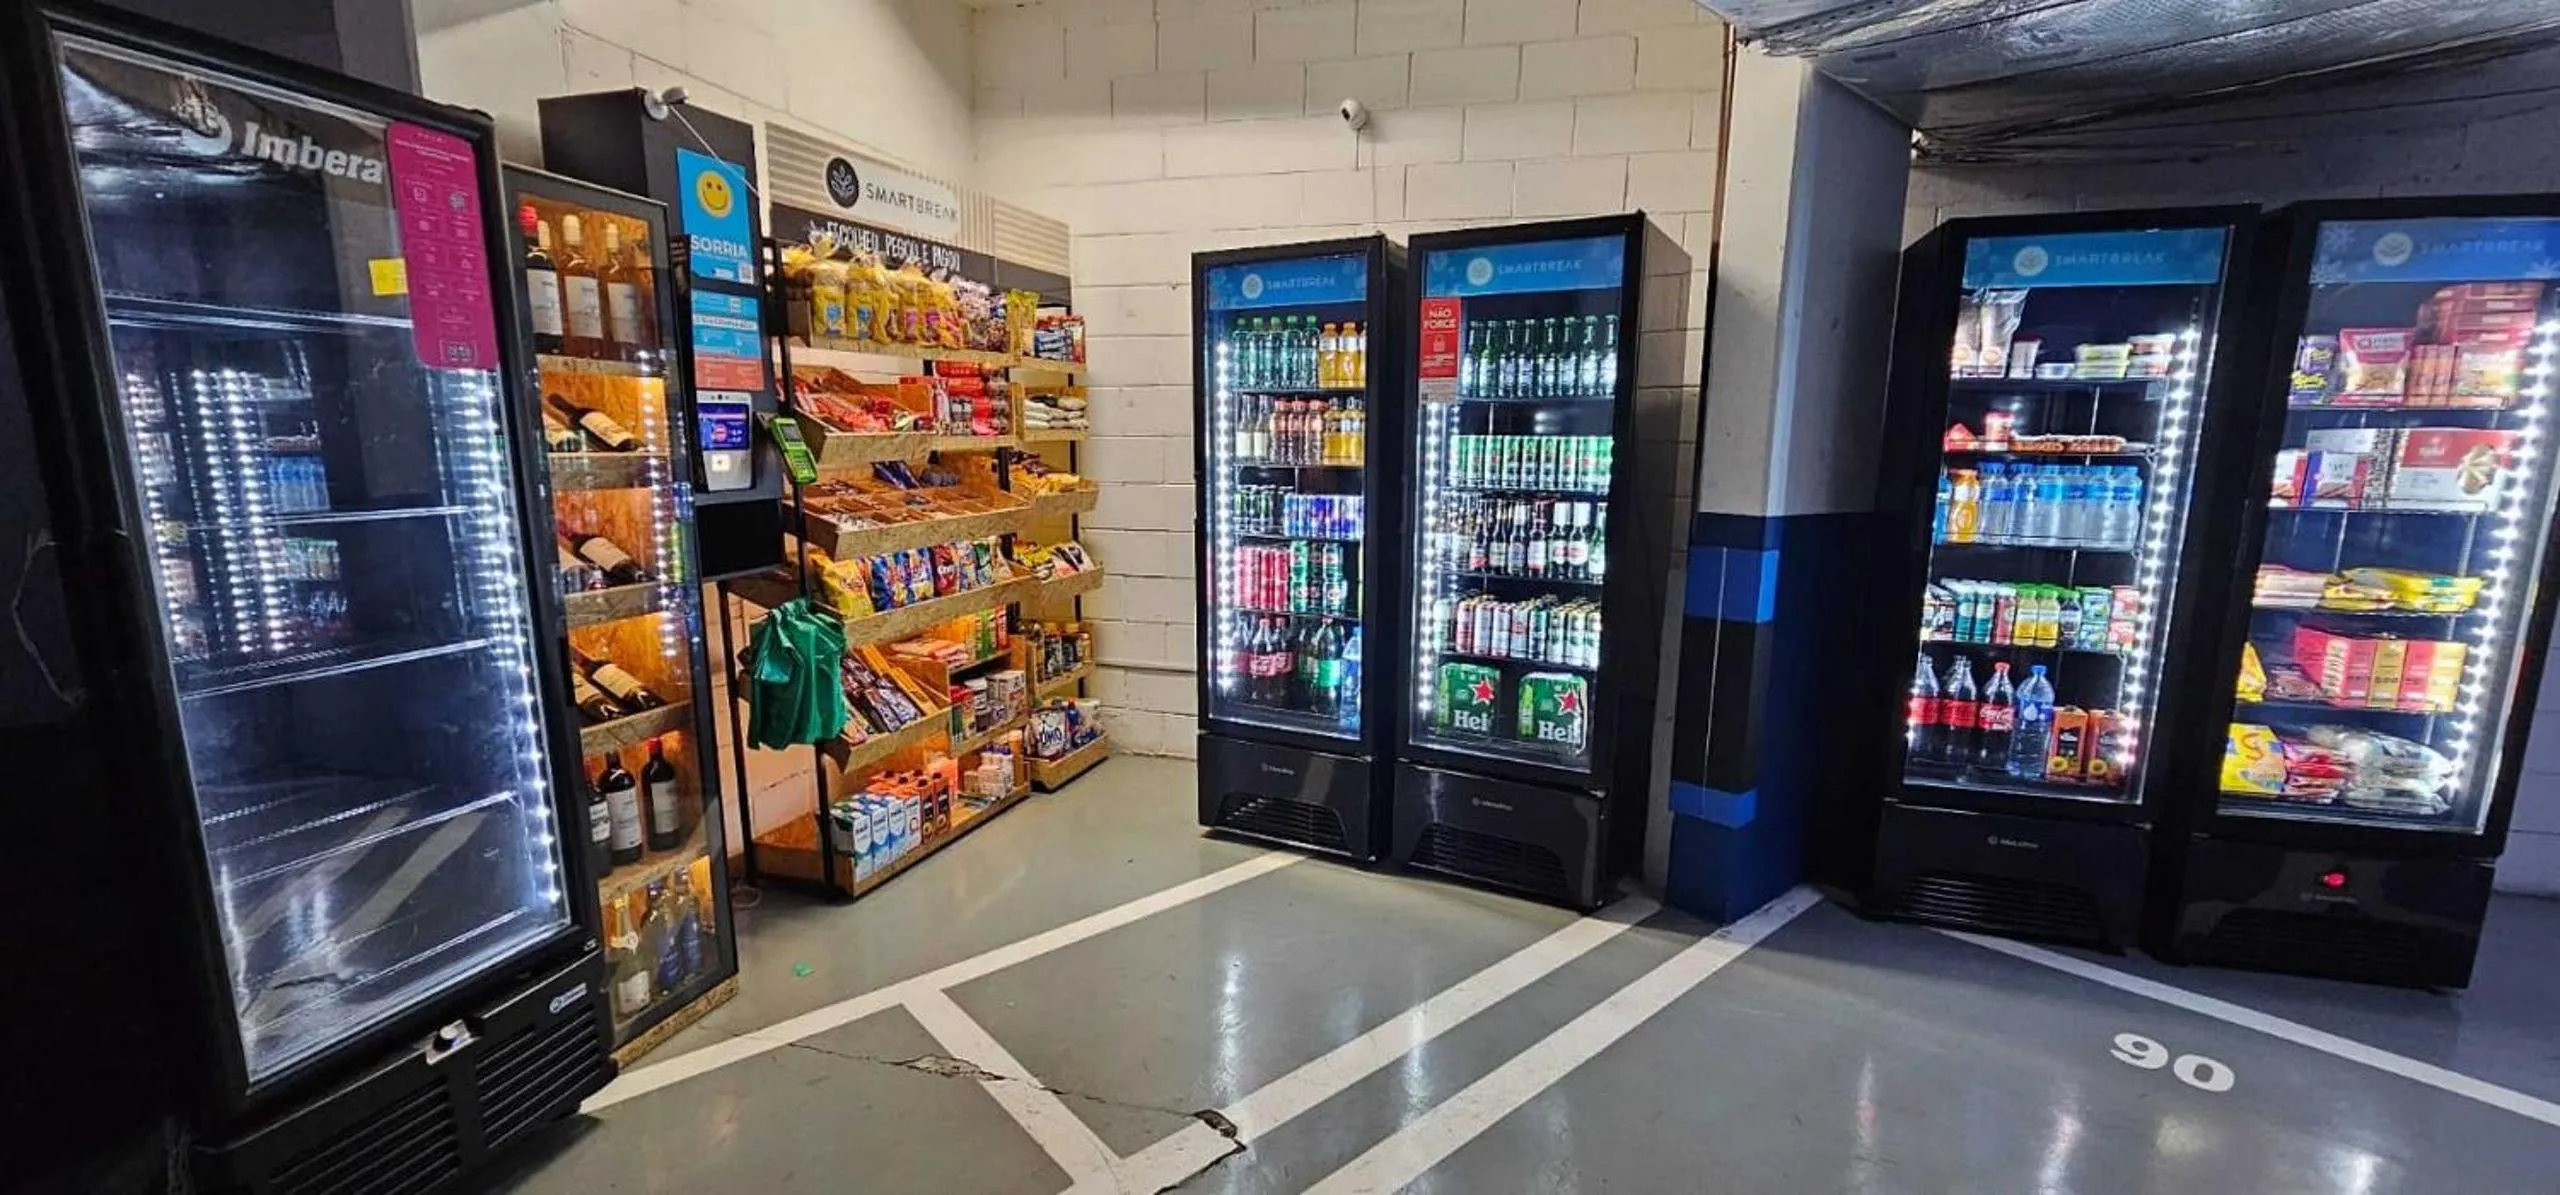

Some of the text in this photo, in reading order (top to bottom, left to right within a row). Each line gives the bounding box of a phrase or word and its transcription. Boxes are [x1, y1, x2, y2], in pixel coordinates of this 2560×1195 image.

[241, 120, 384, 184] Imbera
[865, 182, 958, 222] SMARTBREAK
[690, 234, 747, 258] SORRIA
[2054, 251, 2167, 267] SMARTBREAK
[1498, 258, 1583, 274] SMARTBREAK
[2109, 1032, 2236, 1093] 90
